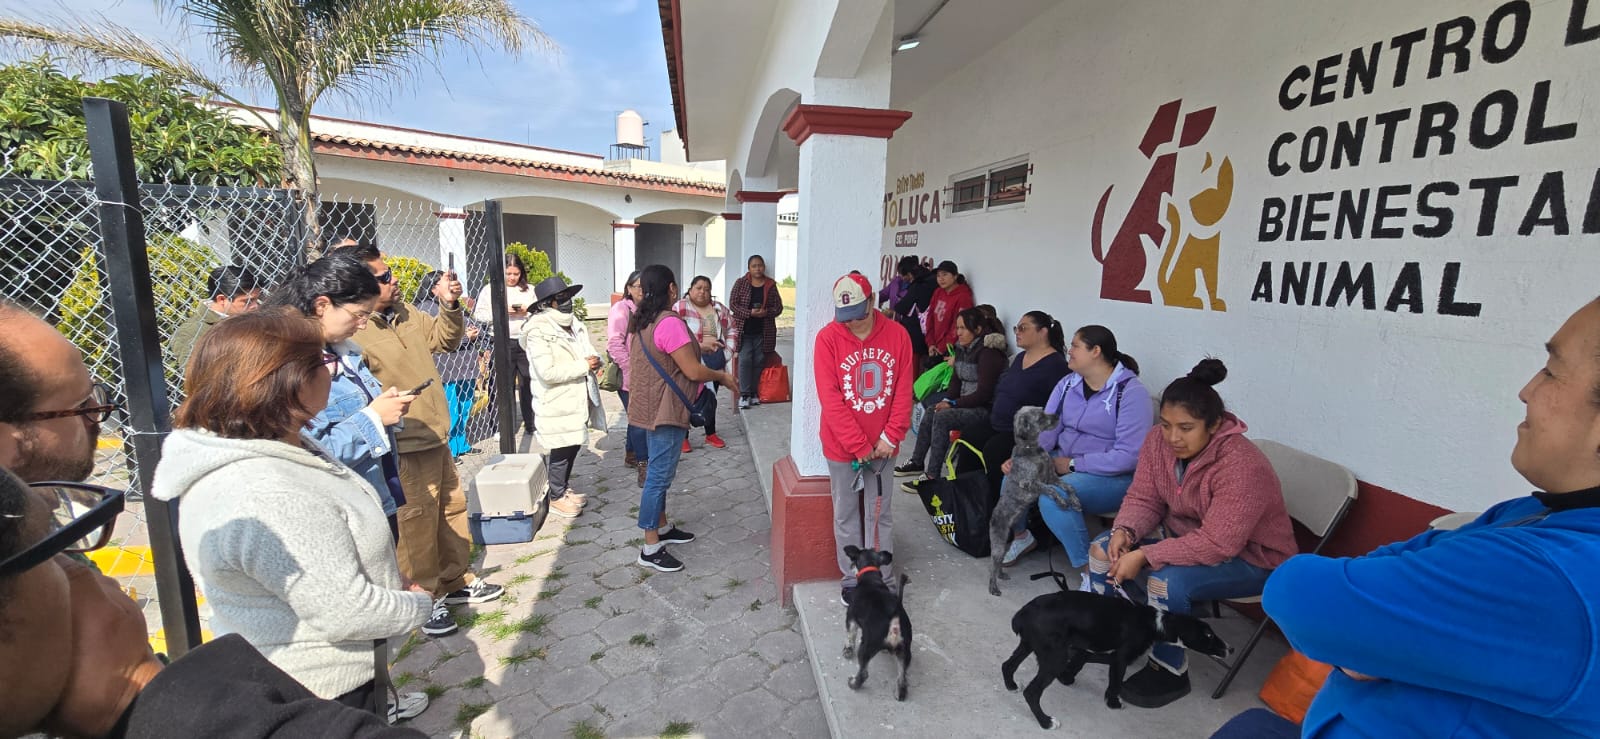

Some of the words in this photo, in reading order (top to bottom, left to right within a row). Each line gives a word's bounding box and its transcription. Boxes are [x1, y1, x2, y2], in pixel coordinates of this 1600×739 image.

[1278, 0, 1531, 111] CENTRO
[1268, 80, 1578, 176] CONTROL
[883, 190, 941, 228] TOLUCA
[1251, 261, 1482, 317] ANIMAL
